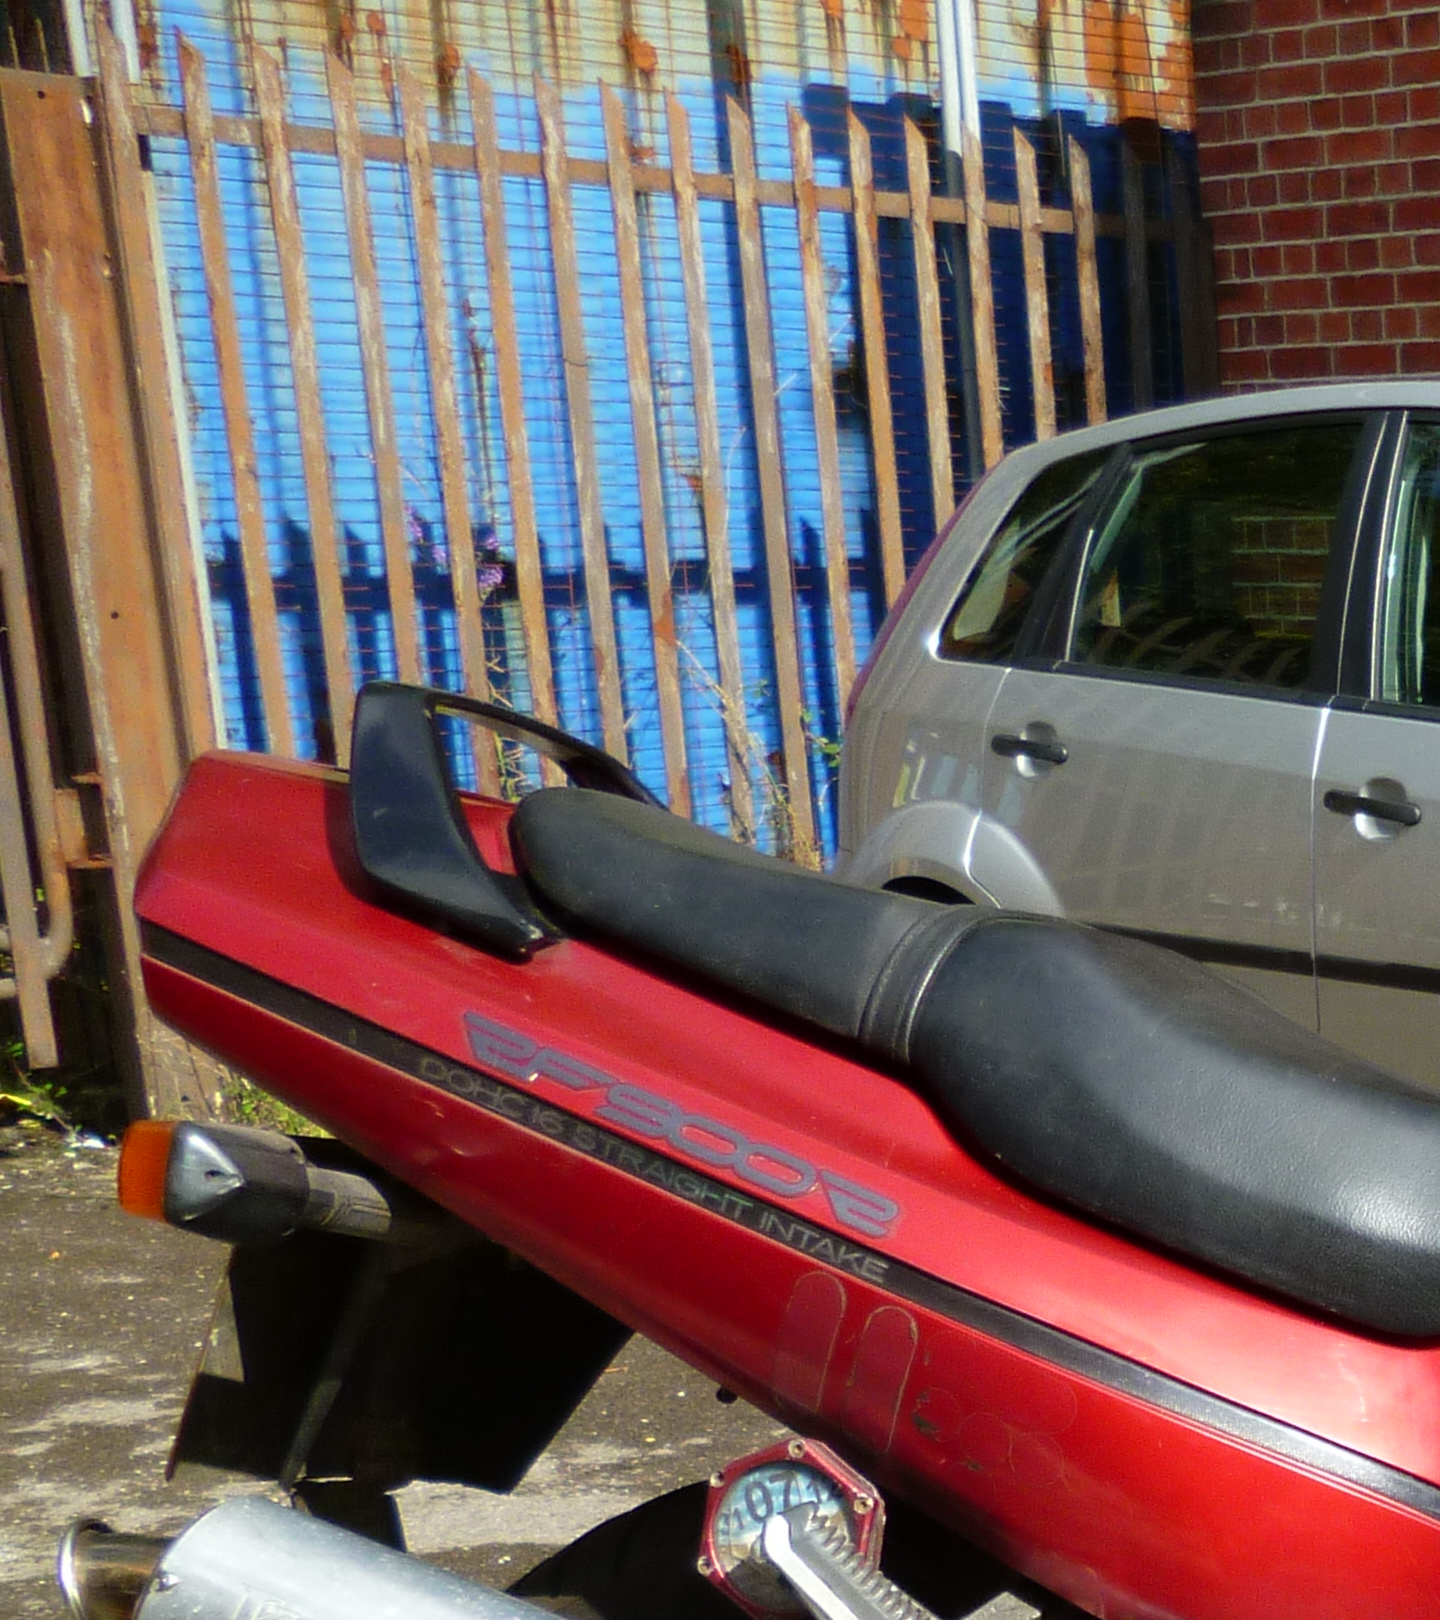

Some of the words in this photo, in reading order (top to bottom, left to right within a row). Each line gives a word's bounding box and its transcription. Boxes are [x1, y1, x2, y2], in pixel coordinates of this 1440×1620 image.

[419, 1056, 528, 1119] DOHC
[572, 1122, 754, 1221] STRAIGHT
[759, 1210, 890, 1285] INTAKE
[463, 1010, 899, 1240] RF900R
